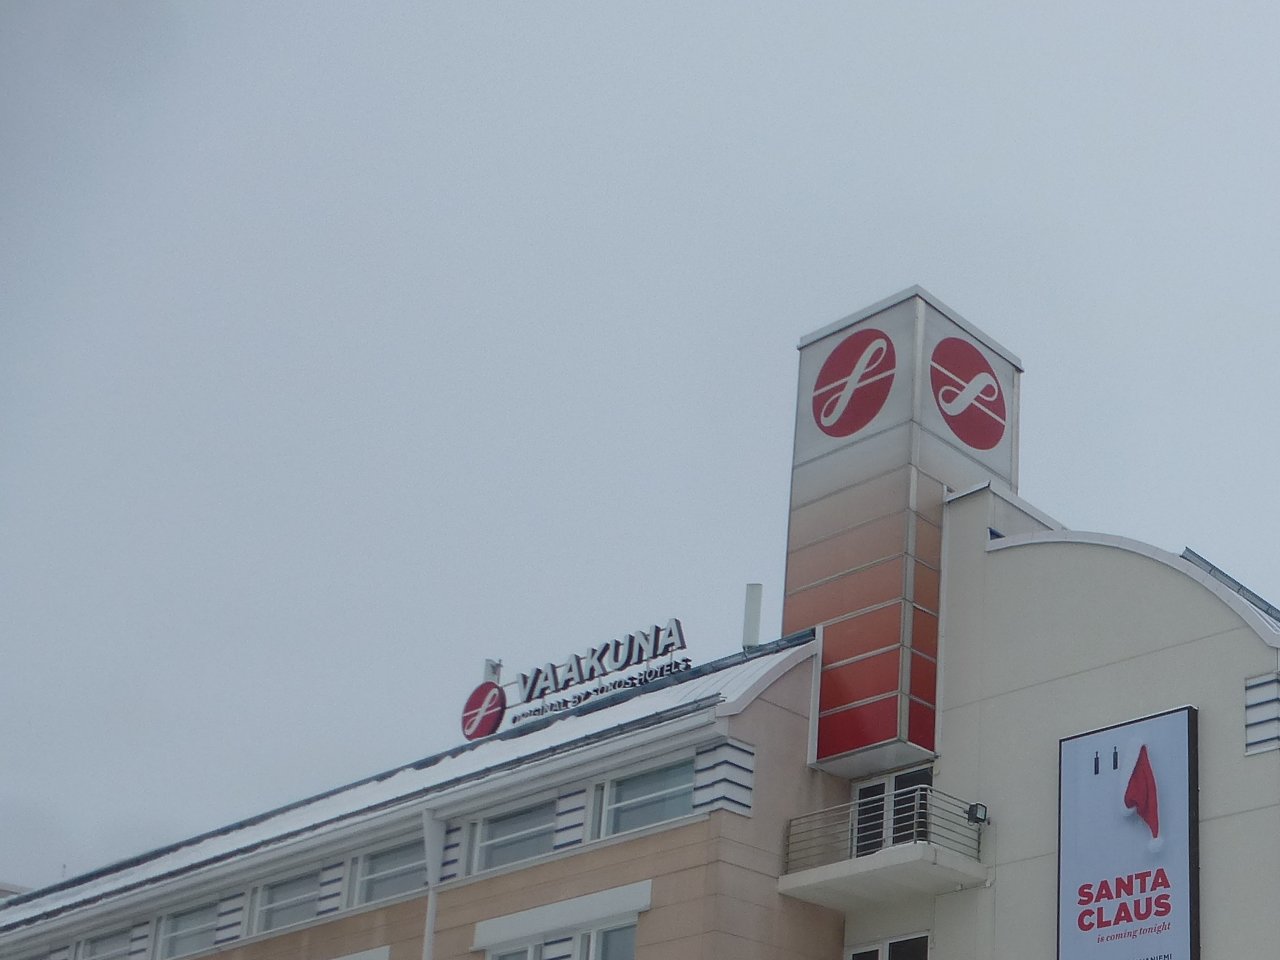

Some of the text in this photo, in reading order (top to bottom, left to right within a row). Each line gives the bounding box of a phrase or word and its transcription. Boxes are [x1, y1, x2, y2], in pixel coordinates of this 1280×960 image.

[516, 617, 687, 703] VAAKUNA
[638, 656, 692, 685] HOTELS
[1077, 867, 1171, 906] SANTA
[1077, 893, 1172, 932] CLAUS
[1096, 921, 1171, 944] is coming tonight
